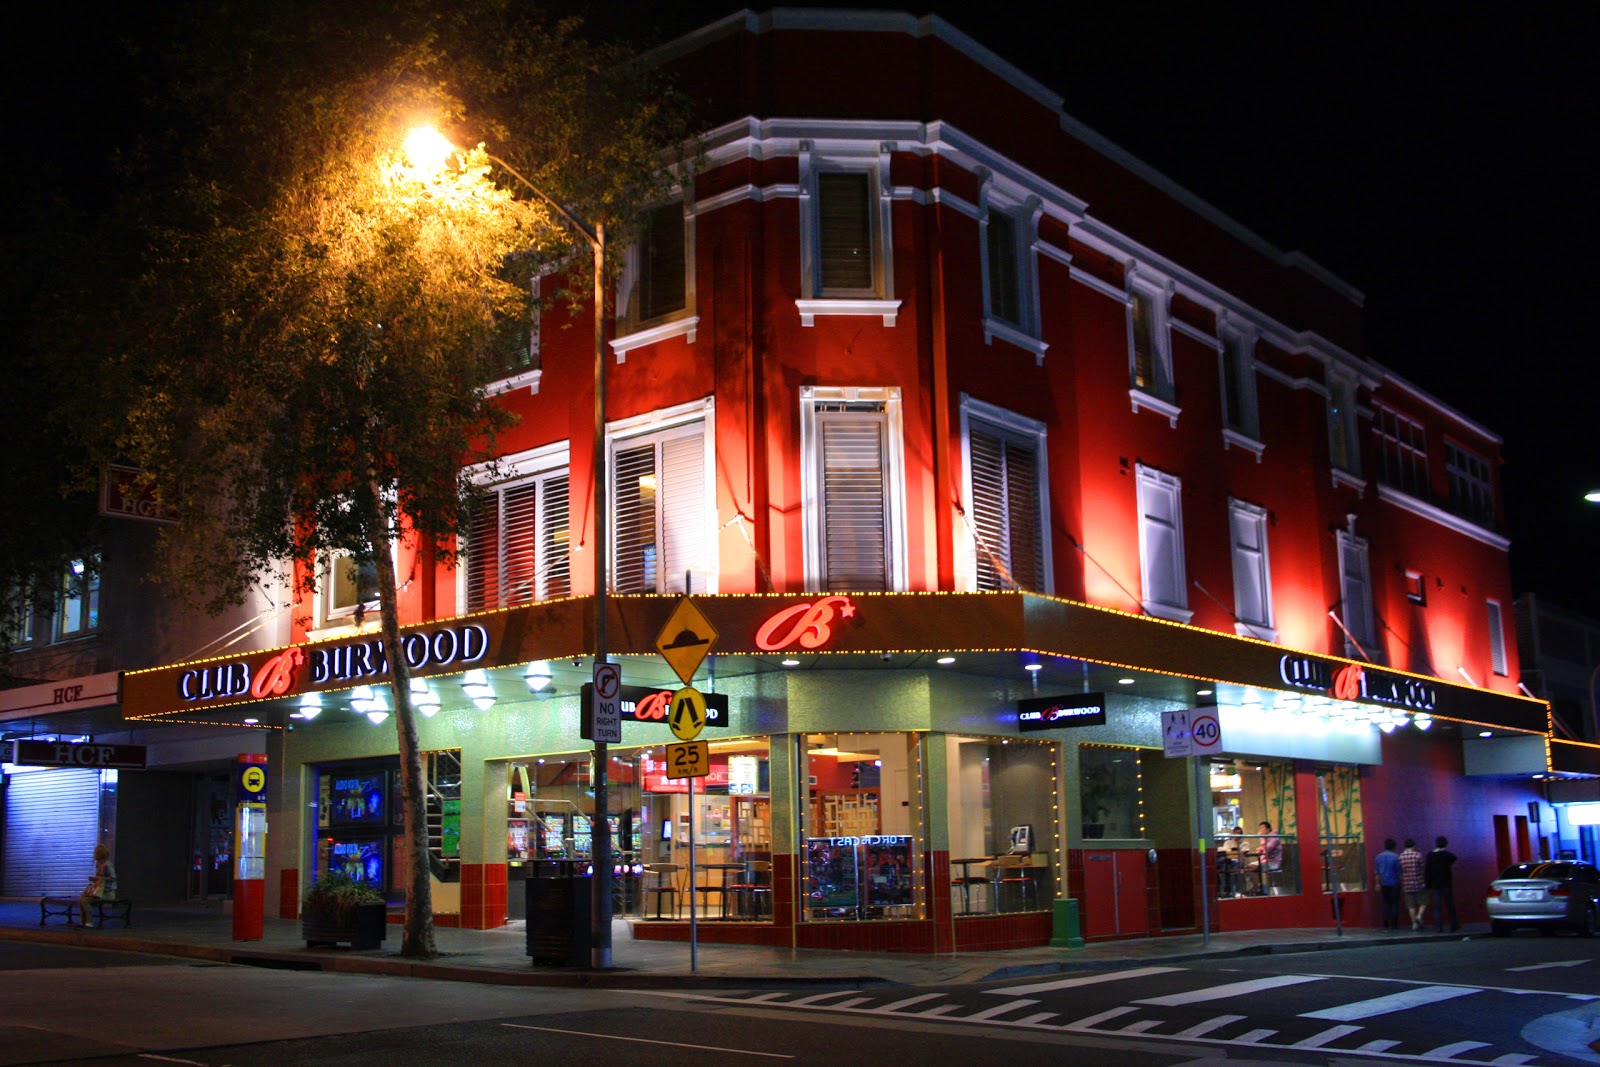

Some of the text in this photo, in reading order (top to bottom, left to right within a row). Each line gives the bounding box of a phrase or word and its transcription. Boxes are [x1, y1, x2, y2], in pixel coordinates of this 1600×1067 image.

[177, 661, 251, 701] CLUB
[53, 685, 83, 704] HCF
[599, 703, 615, 715] NO
[596, 717, 617, 726] RIGHT
[597, 728, 617, 738] TURN
[1196, 723, 1217, 739] 40
[53, 744, 115, 765] HCF
[674, 745, 700, 767] 25
[677, 766, 699, 776] km/h
